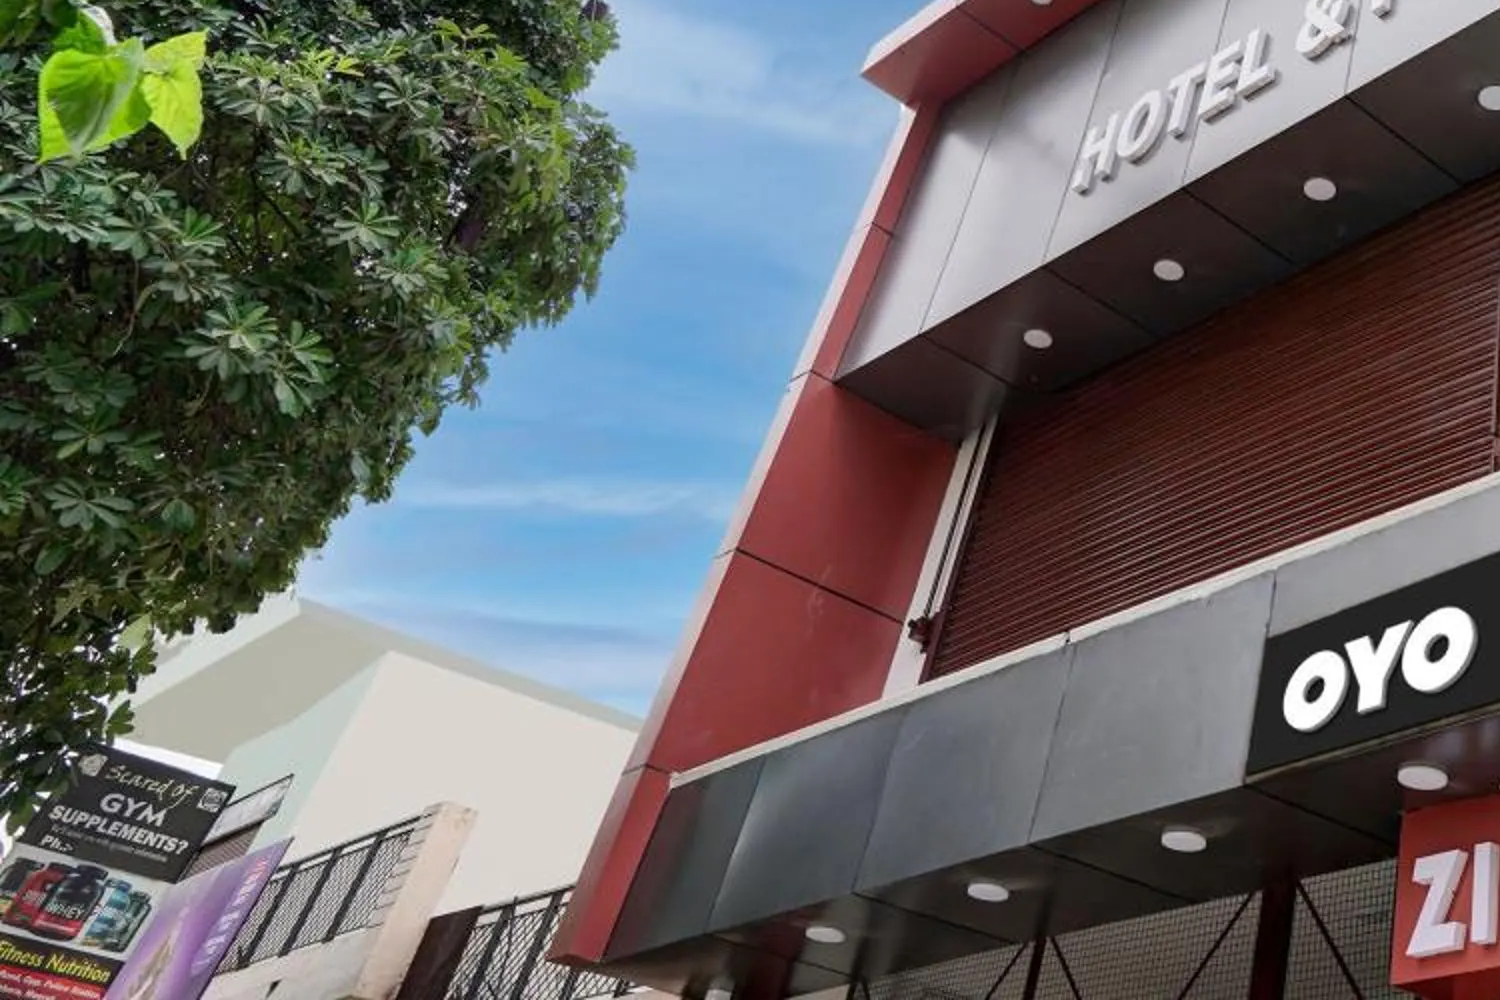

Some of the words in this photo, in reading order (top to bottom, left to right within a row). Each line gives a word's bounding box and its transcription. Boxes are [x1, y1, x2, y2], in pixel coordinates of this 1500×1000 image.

[1070, 27, 1278, 194] HOTEL
[1282, 605, 1478, 732] OYO
[105, 764, 174, 801] Scared
[49, 805, 189, 855] SUPPLEMENTS?
[100, 793, 167, 827] GYM
[45, 952, 111, 983] Nutrition
